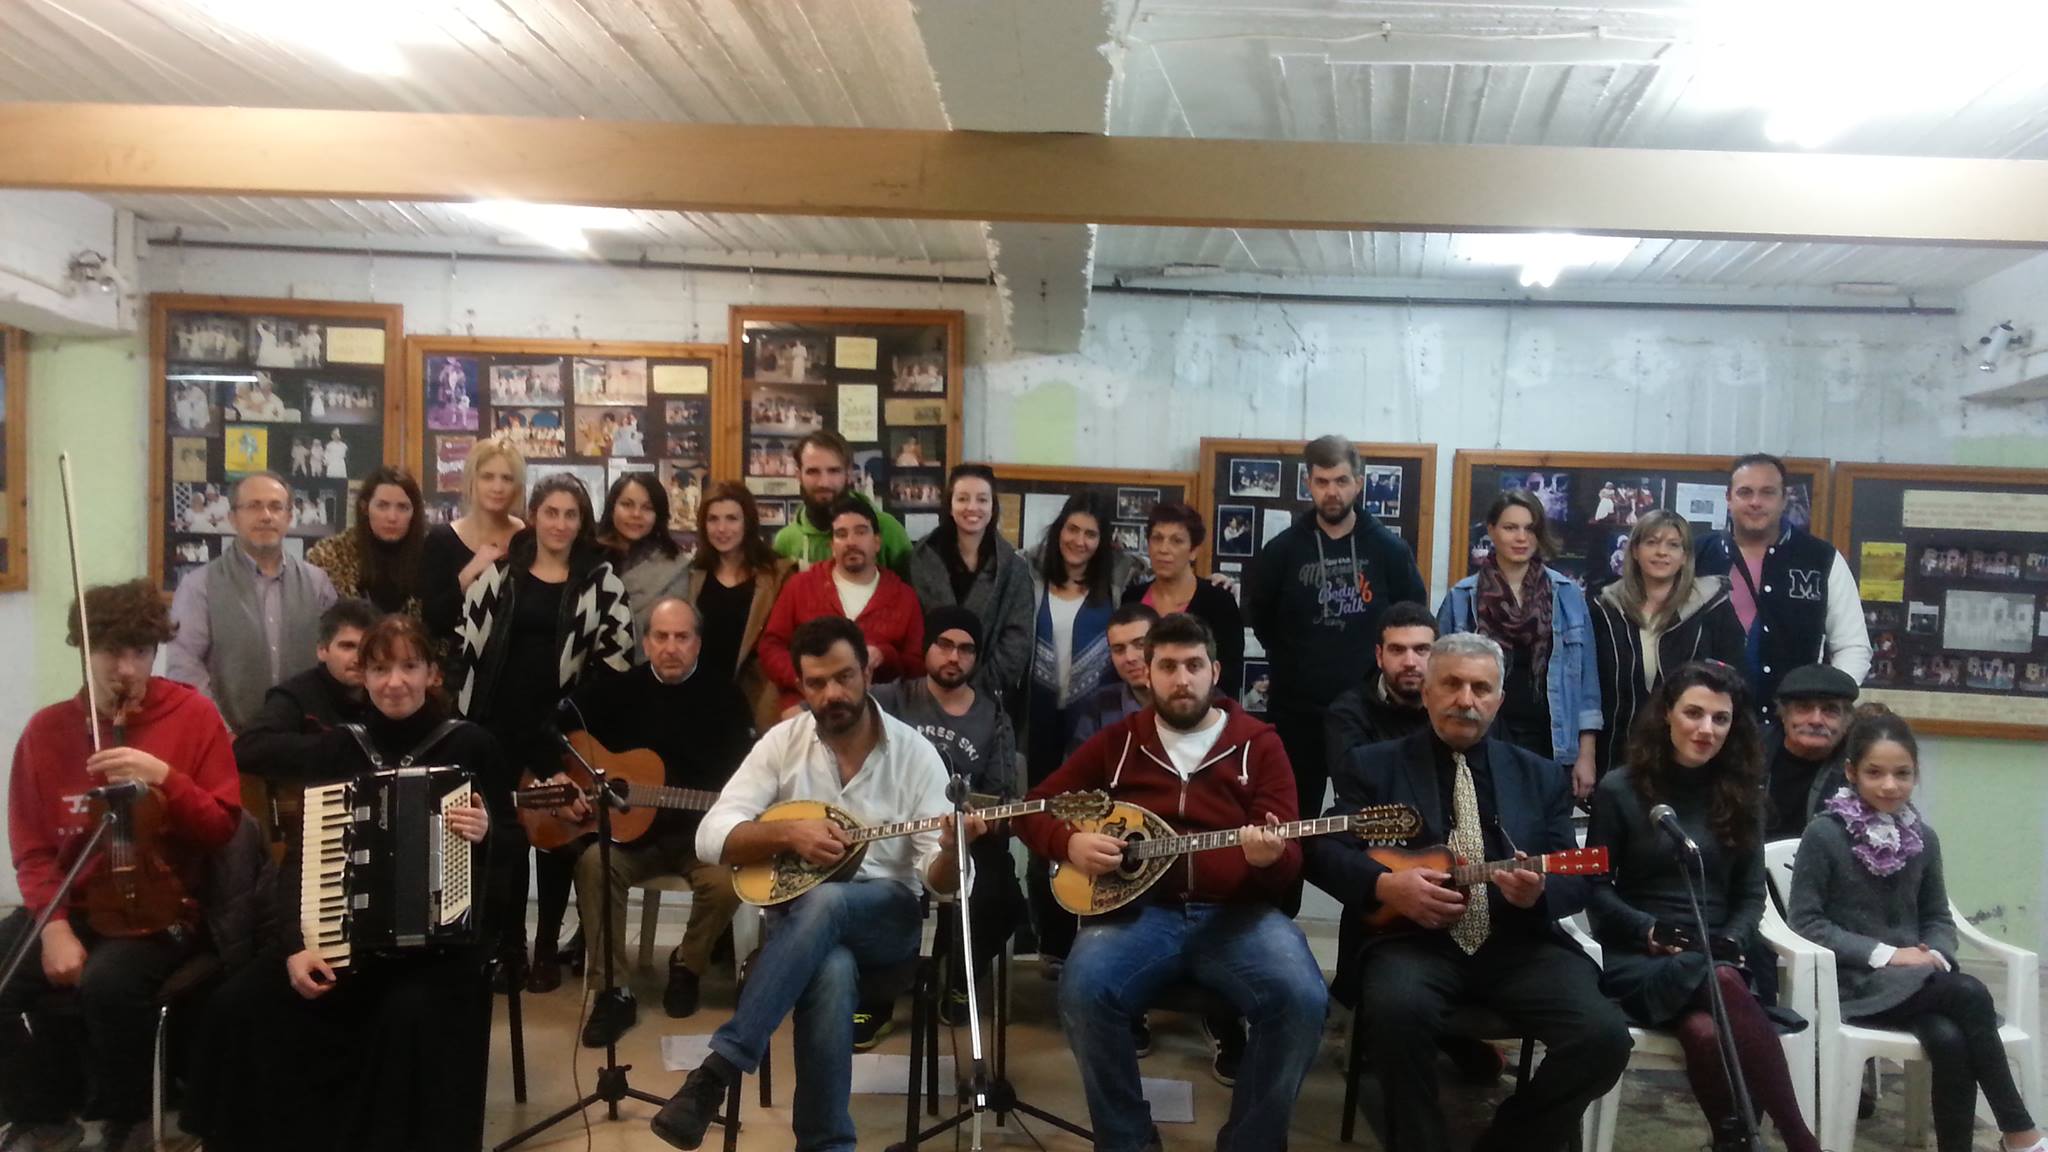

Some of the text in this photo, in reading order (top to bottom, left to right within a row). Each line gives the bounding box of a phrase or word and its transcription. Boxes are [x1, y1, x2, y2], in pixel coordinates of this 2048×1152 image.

[1318, 581, 1356, 604] Body
[1789, 568, 1821, 600] M
[1334, 596, 1366, 617] Talk
